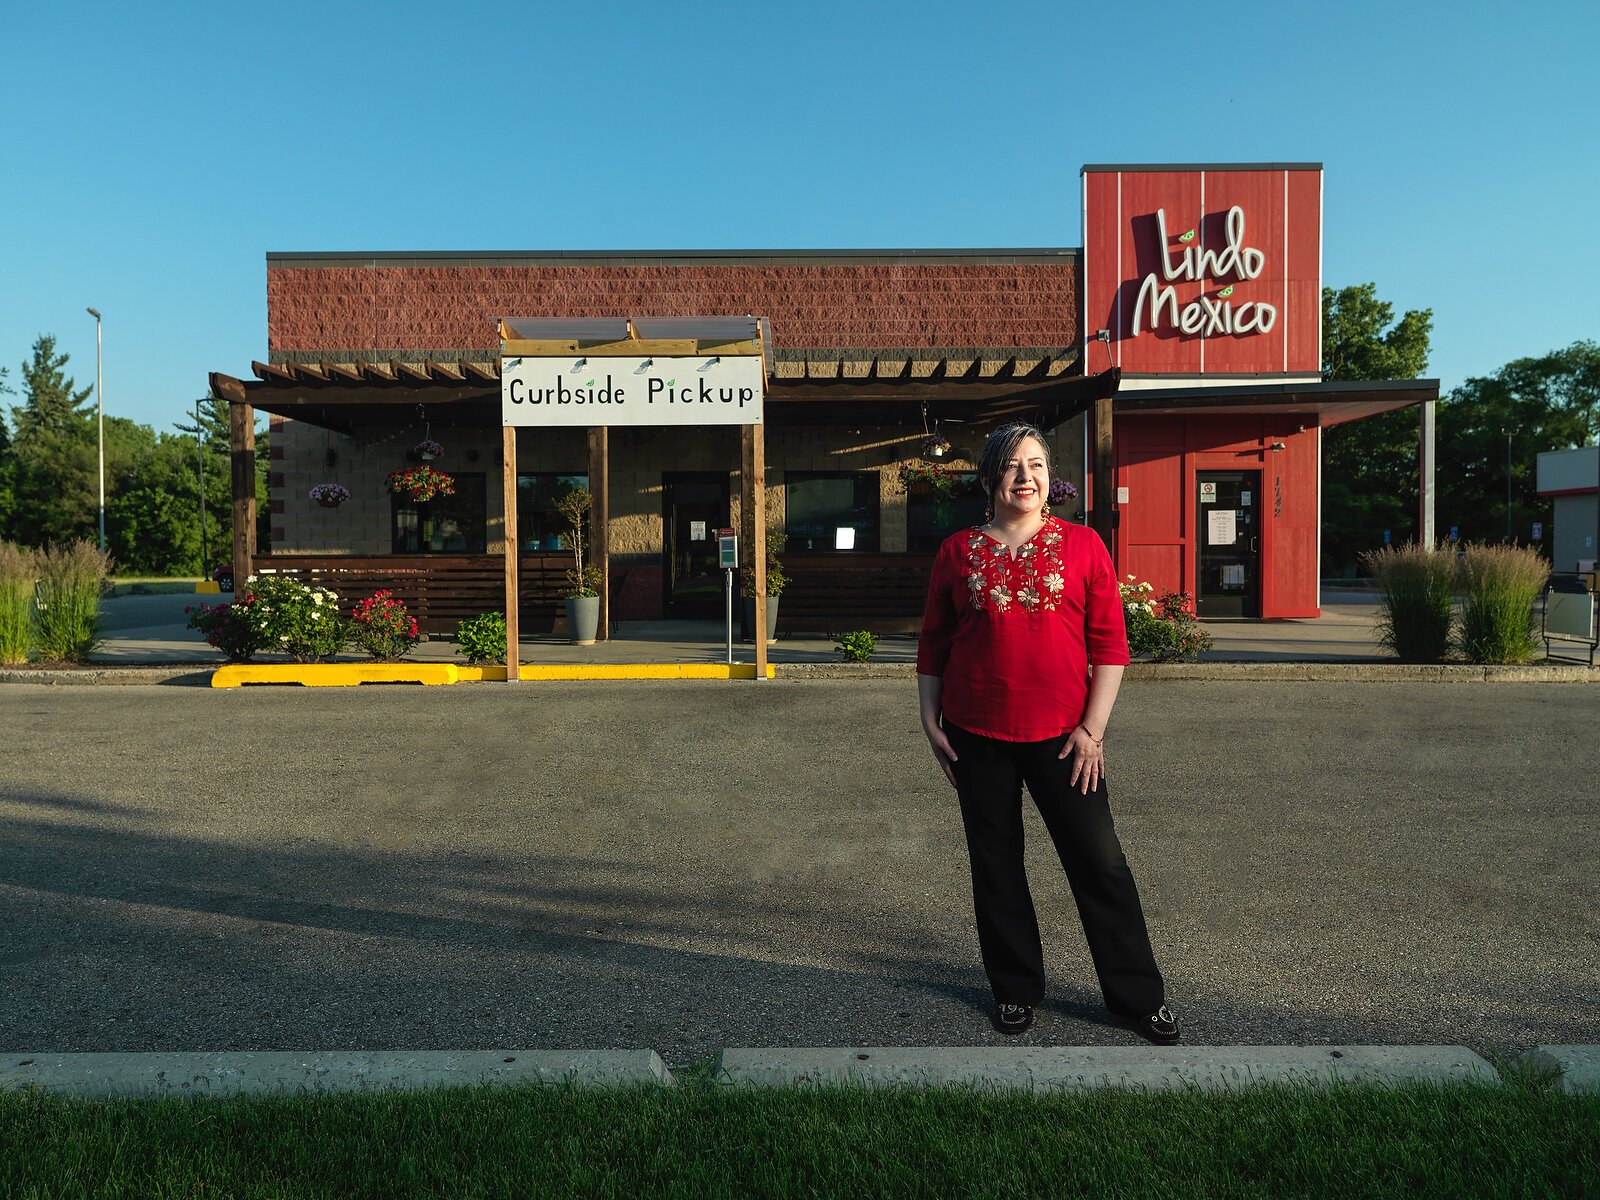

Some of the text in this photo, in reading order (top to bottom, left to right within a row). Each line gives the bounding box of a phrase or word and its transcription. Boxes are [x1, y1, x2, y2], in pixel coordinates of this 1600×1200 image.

[1157, 205, 1265, 281] Lindo
[1132, 272, 1277, 337] Mexico
[509, 374, 754, 408] Curbside Pickup
